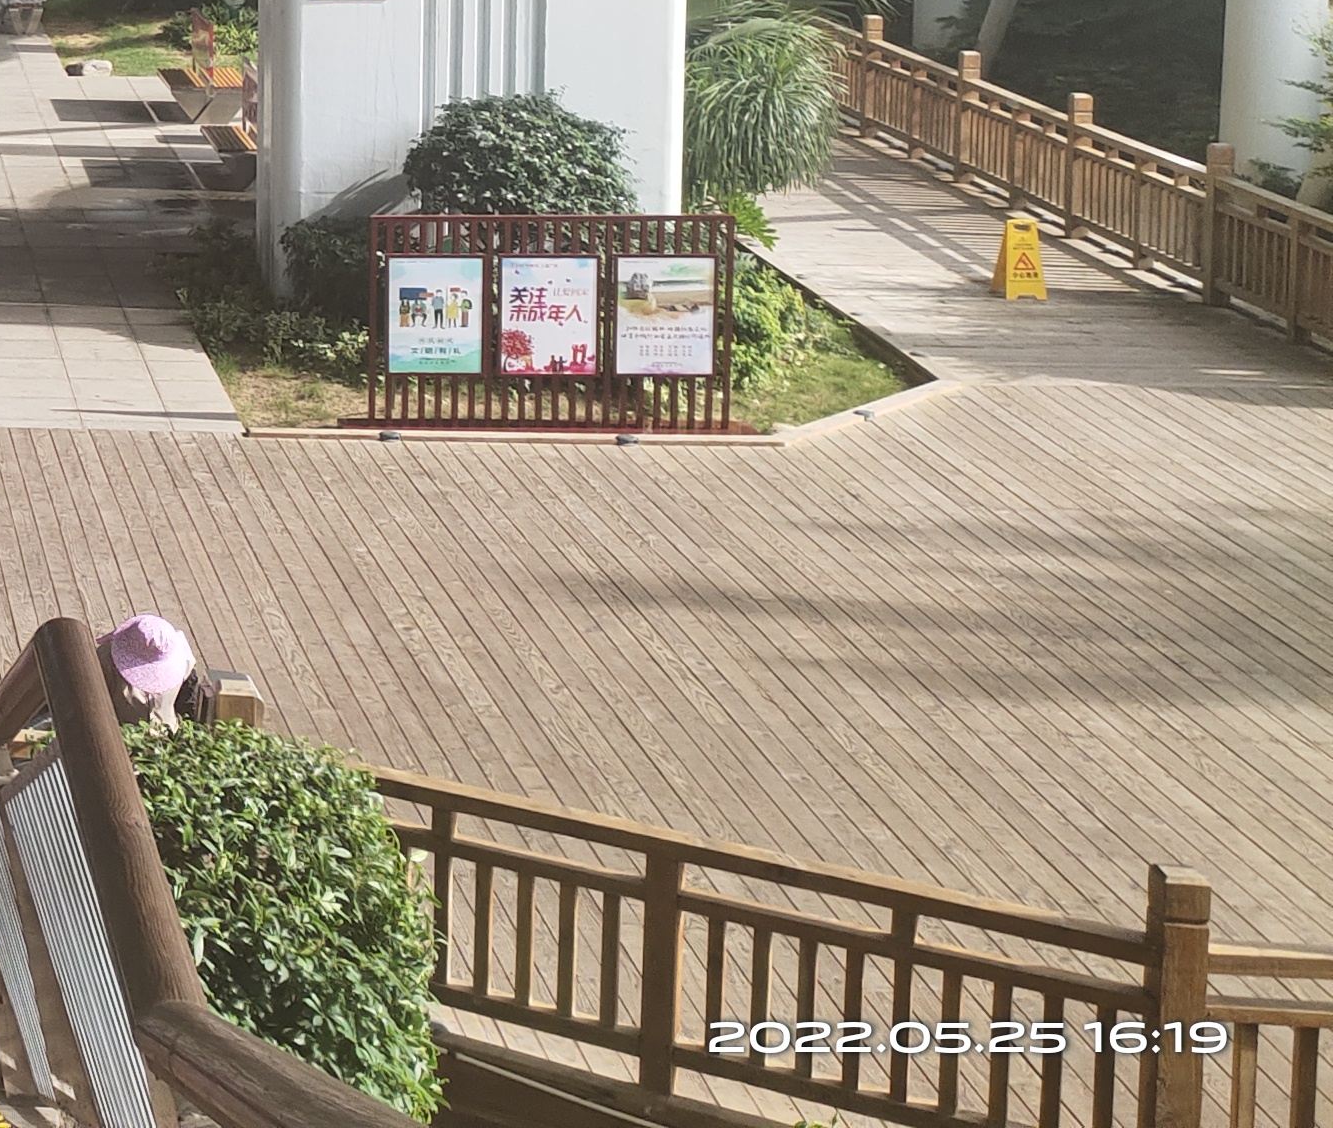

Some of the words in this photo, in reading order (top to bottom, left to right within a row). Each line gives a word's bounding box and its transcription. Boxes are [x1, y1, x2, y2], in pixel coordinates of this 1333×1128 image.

[509, 286, 548, 305] 关注
[509, 304, 583, 322] 未成年人
